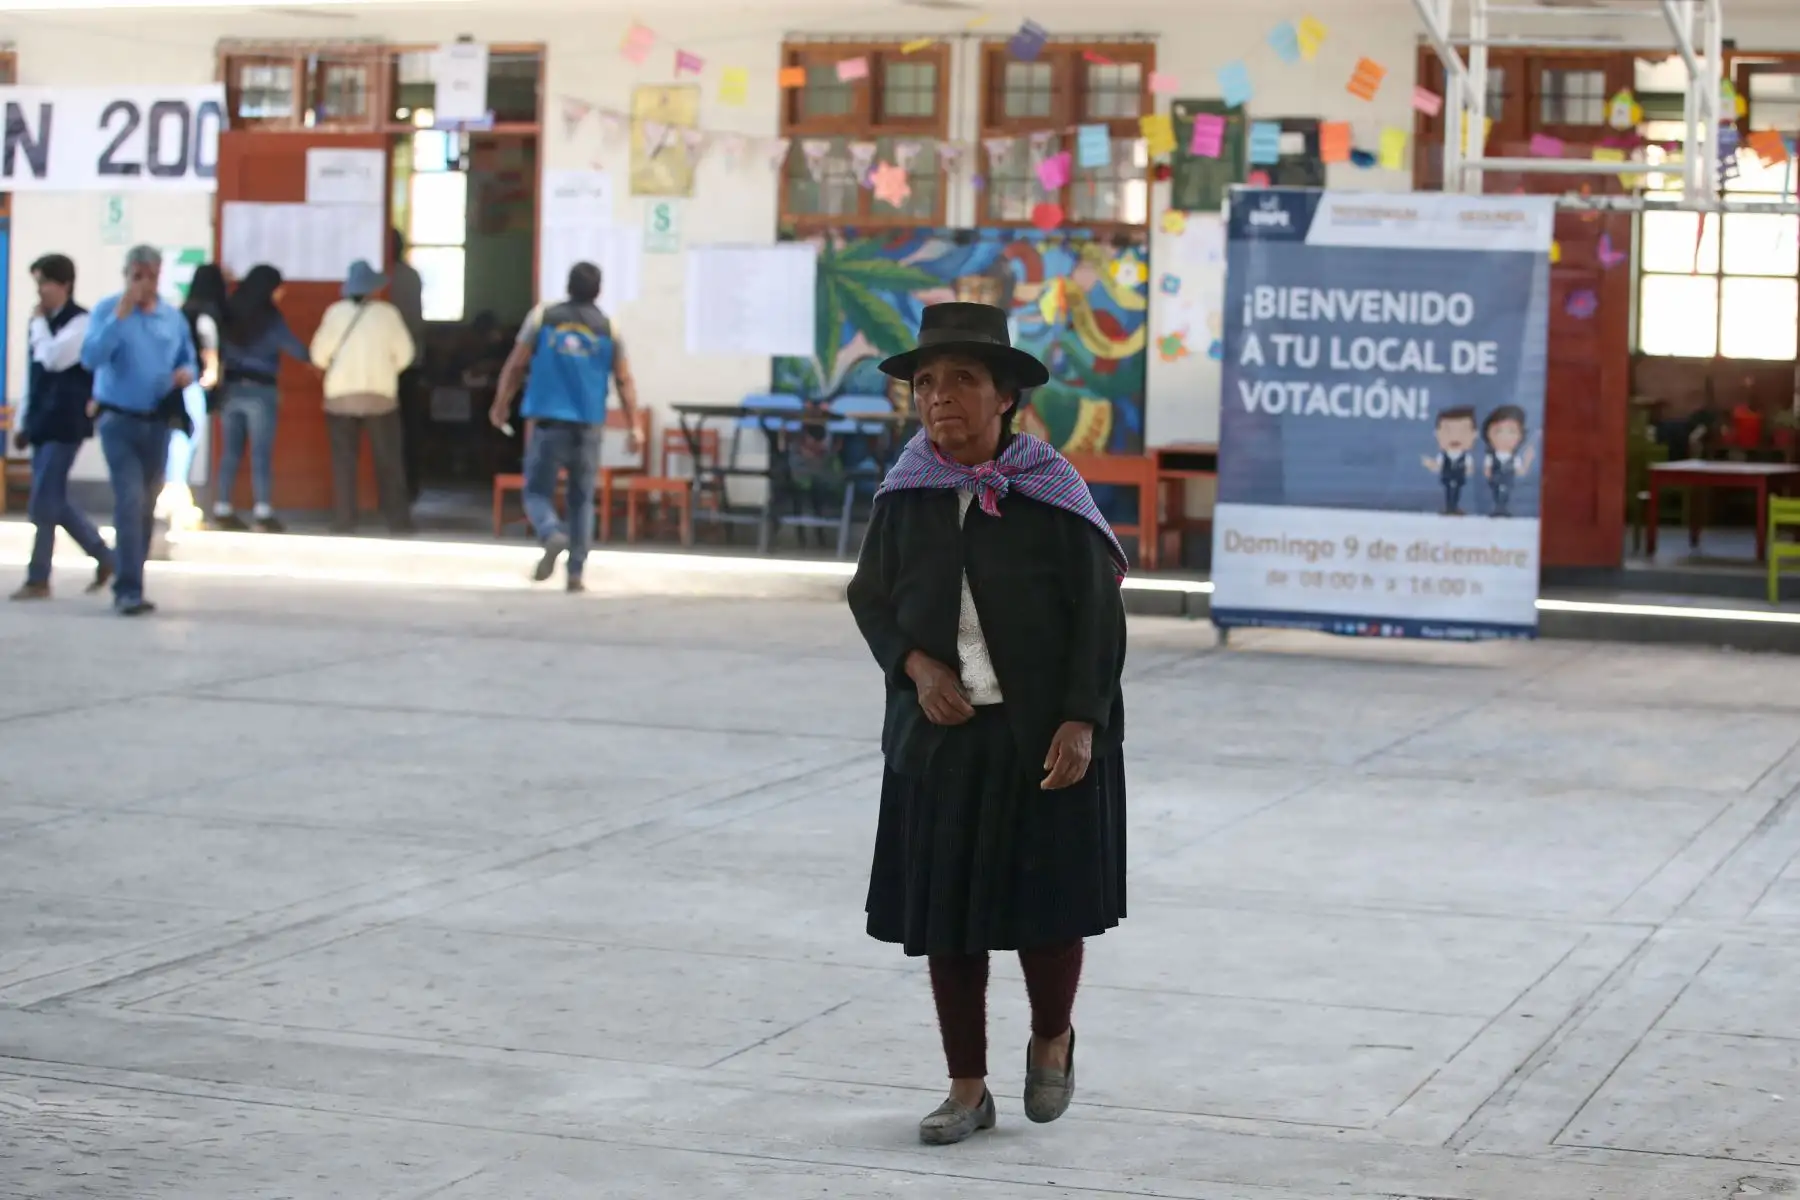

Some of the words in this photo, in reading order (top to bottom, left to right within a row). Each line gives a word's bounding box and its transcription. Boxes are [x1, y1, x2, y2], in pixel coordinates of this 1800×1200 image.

[3, 102, 54, 179] N
[654, 203, 670, 232] S
[1243, 285, 1475, 327] ¡BIENVENIDO
[1240, 331, 1265, 367] A
[1270, 334, 1320, 368] TU
[1330, 336, 1445, 374] LOCAL
[1451, 340, 1498, 375] DE
[1238, 378, 1430, 421] VOTACIÓN!
[1225, 529, 1335, 563] Domingo
[1344, 535, 1359, 558] 9
[1367, 538, 1397, 561] de
[1405, 539, 1529, 568] diciembre
